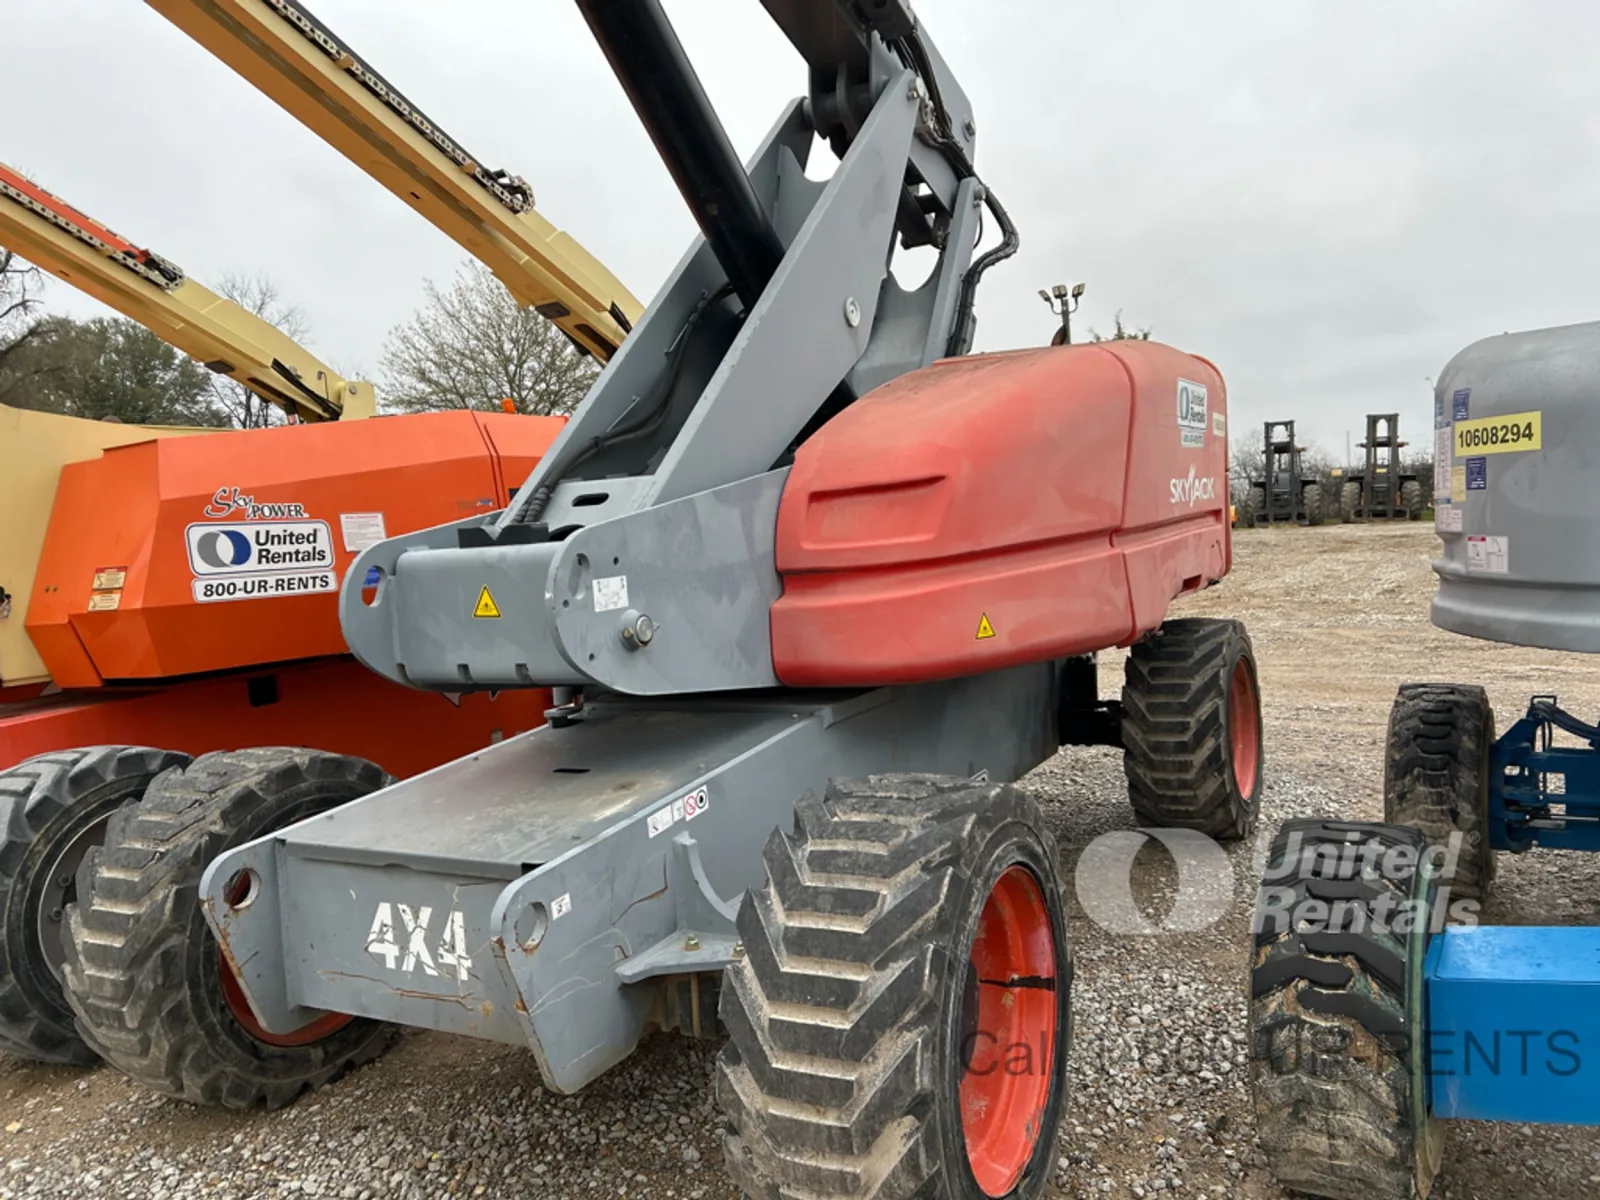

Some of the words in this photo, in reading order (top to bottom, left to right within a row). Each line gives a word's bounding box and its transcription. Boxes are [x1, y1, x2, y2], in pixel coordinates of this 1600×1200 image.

[1458, 421, 1535, 449] 10608294
[1170, 463, 1215, 507] SKYJACK
[254, 528, 319, 547] United
[256, 548, 327, 565] Rentals
[202, 574, 330, 598] 800-UR-RENTS
[366, 901, 472, 981] 4X4
